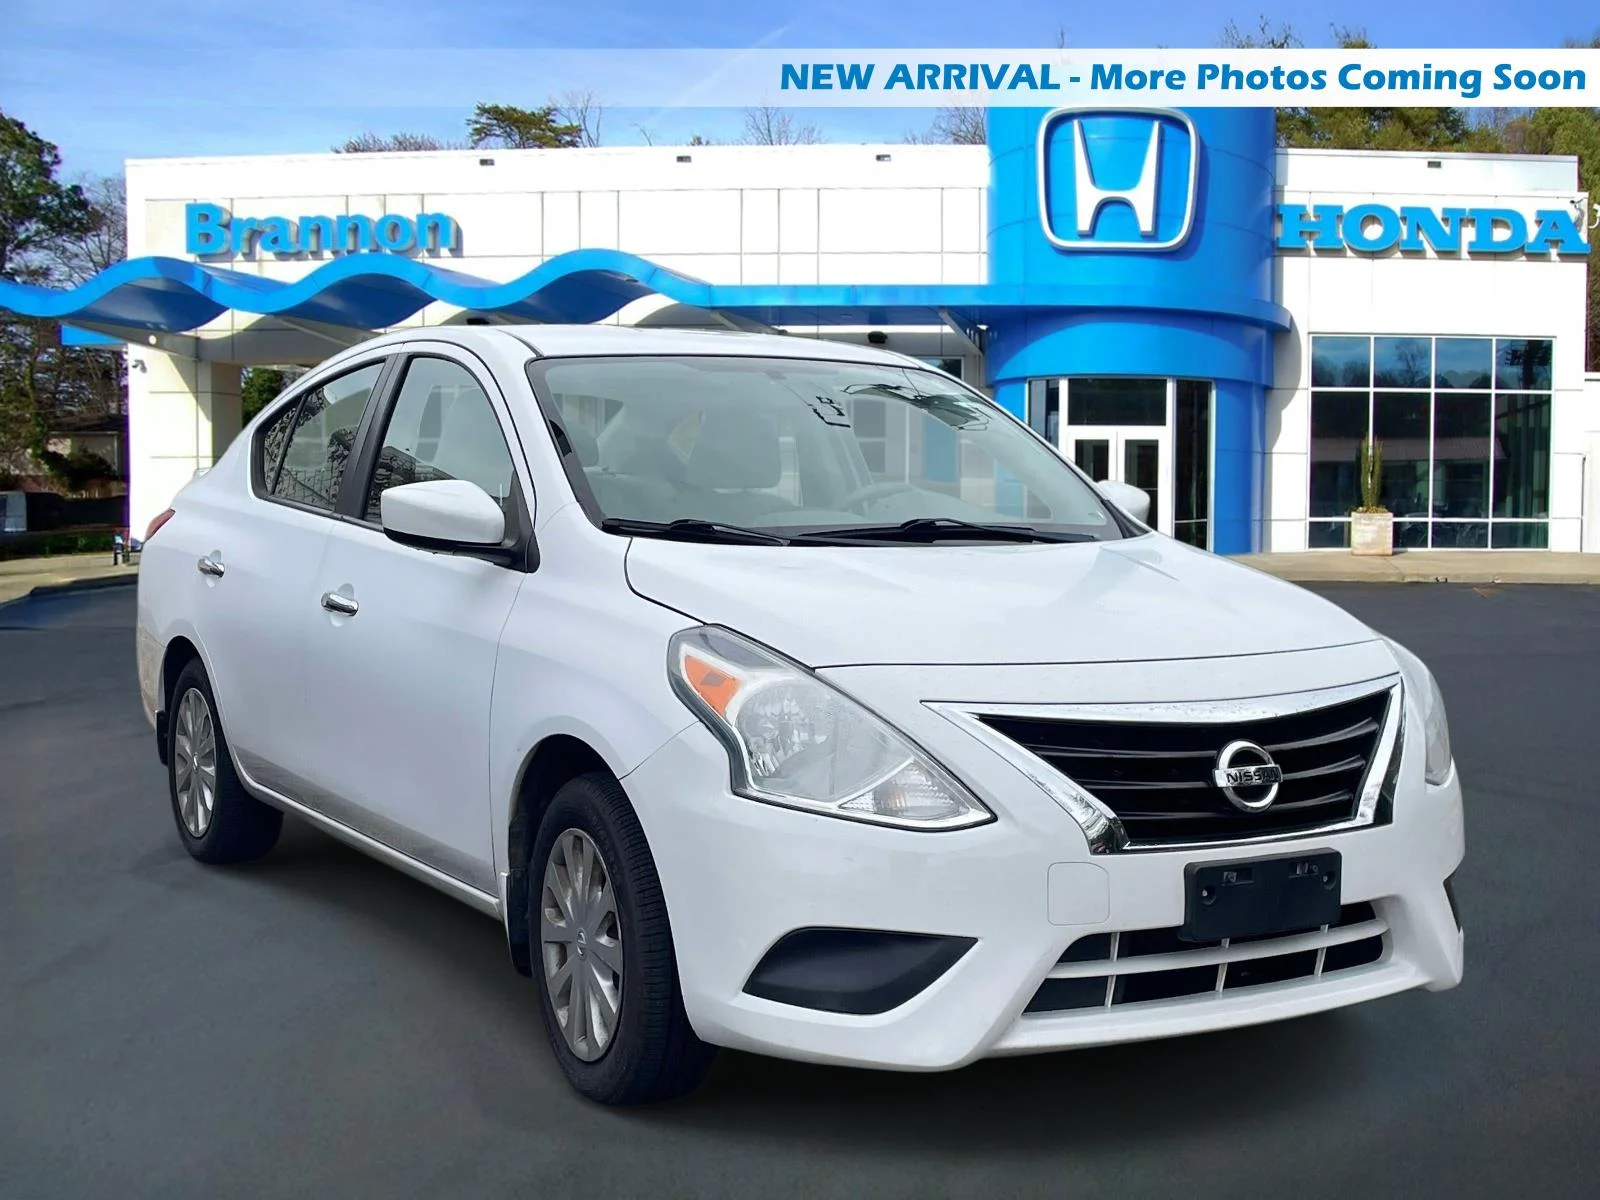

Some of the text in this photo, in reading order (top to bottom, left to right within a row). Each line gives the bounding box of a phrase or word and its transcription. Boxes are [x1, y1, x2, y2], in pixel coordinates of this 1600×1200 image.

[186, 203, 459, 257] Brannon
[1276, 203, 1591, 255] HONDA
[1226, 768, 1279, 783] NISSAN
